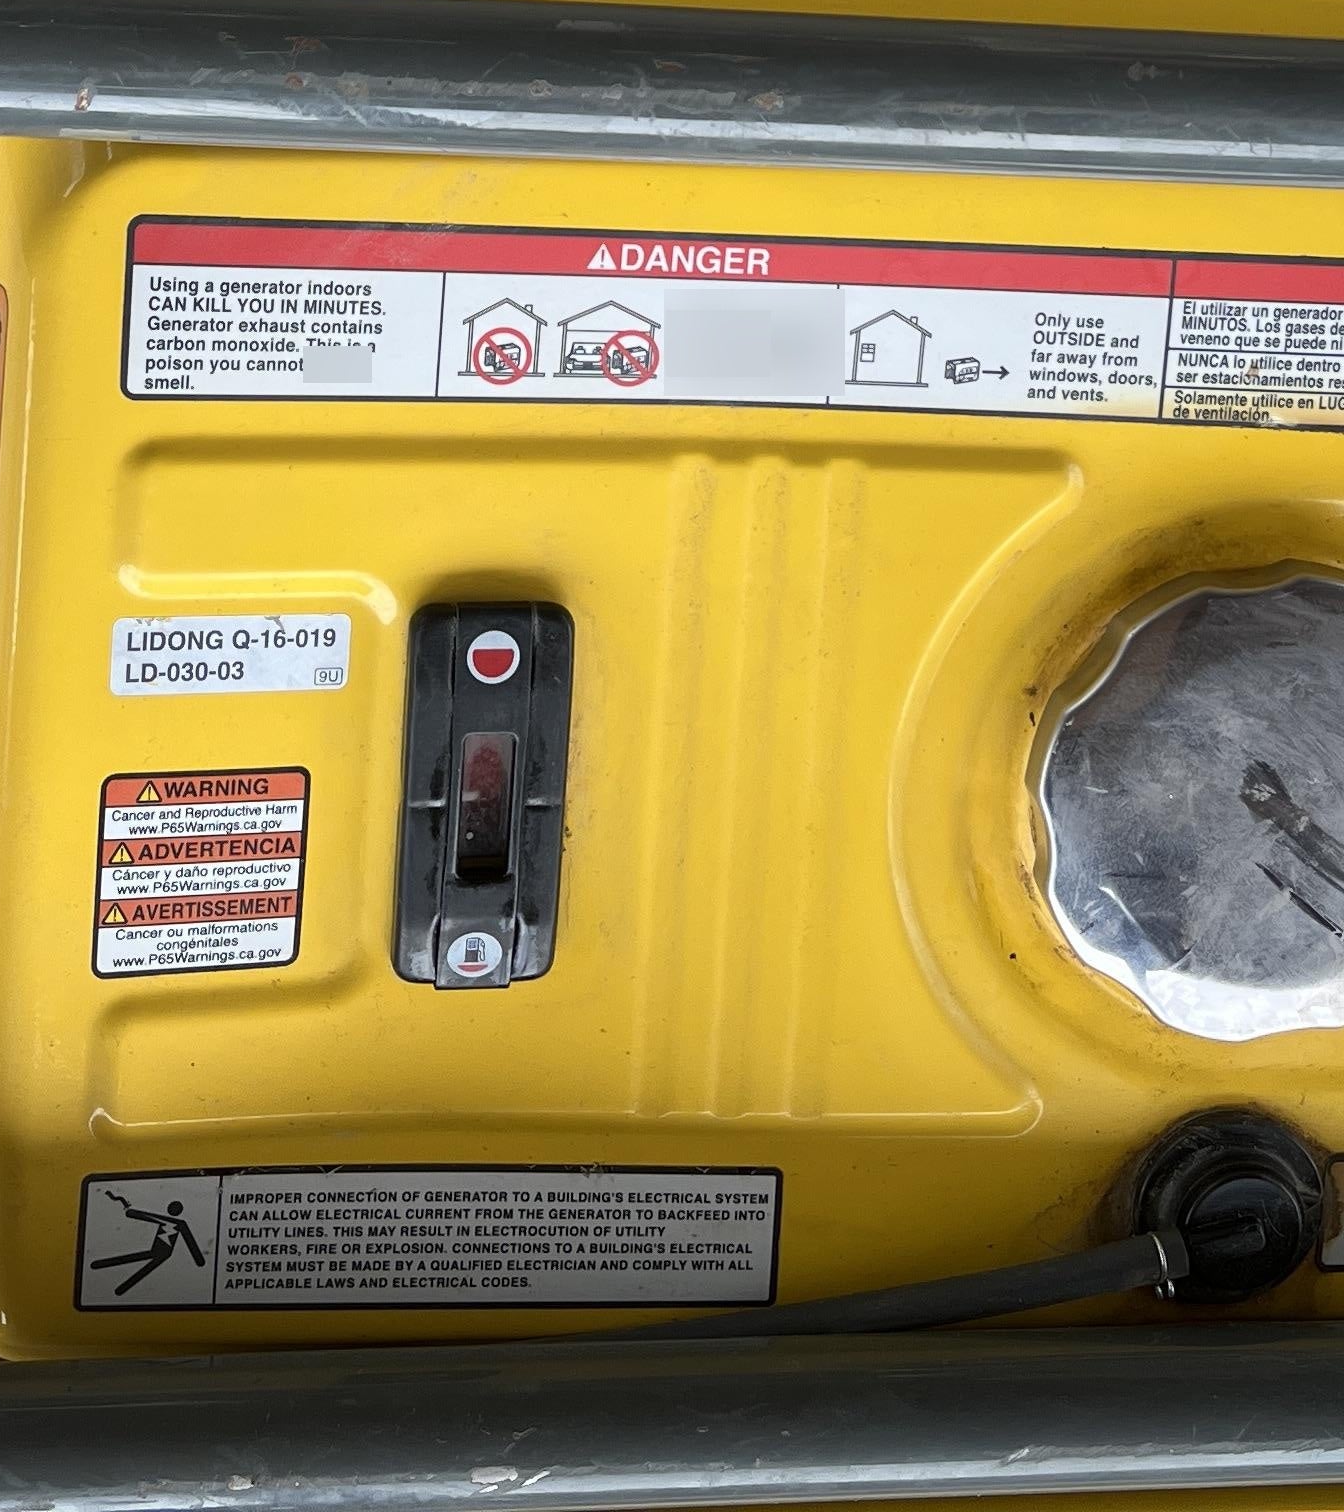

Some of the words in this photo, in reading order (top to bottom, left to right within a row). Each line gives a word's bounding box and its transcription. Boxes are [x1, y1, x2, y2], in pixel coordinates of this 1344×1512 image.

[620, 244, 770, 275] DANGER
[149, 276, 199, 297] Using
[204, 281, 214, 293] a
[219, 278, 302, 299] generator
[307, 280, 372, 296] indoors
[148, 297, 186, 312] CAN
[192, 297, 232, 313] KILL
[236, 298, 274, 314] YOU
[280, 299, 297, 314] IN
[303, 299, 386, 316] MINUTES.
[1182, 302, 1196, 314] El
[1200, 302, 1248, 316] utilizar
[1251, 307, 1268, 317] un
[1272, 305, 1344, 323] generador
[147, 315, 233, 332] Generator
[238, 317, 306, 334] exhaust
[310, 318, 383, 335] contains
[1033, 313, 1070, 332] Only
[1075, 317, 1104, 329] use
[146, 336, 205, 351] carbon
[211, 337, 300, 353] monoxide.
[1032, 332, 1105, 347] OUTSIDE
[1110, 334, 1139, 348] and
[144, 355, 203, 374] poison
[208, 359, 240, 375] you
[245, 356, 304, 372] cannot
[1030, 350, 1052, 364] far
[1056, 354, 1096, 369] away
[1101, 351, 1138, 366] from
[144, 374, 195, 390] smell.
[1028, 369, 1102, 388] windows,
[1107, 370, 1157, 389] doors,
[1026, 385, 1056, 400] and
[1060, 386, 1108, 402] vents.
[1172, 406, 1190, 419] de
[1193, 407, 1273, 421] ventilación.
[127, 629, 223, 652] LIDONG
[231, 626, 336, 654] Q-16-019
[125, 662, 244, 684] LD-030-03
[318, 670, 340, 685] 9U
[164, 778, 269, 799] WARNING
[111, 809, 155, 823] Cancer
[158, 808, 181, 821] and
[184, 804, 261, 823] Reproductive
[265, 803, 297, 817] Harm
[128, 818, 282, 837] www.P65Warnings.ca.gov
[138, 838, 296, 860] ADVERTENCIA
[111, 867, 160, 882] Cáncer
[163, 870, 171, 883] y
[175, 865, 208, 879] daño
[212, 861, 291, 881] reproductivo
[117, 876, 287, 896] www.P65Warnings.ca.gov
[132, 897, 292, 922] AVERTISSEMENT
[115, 925, 162, 940] Cancer
[166, 927, 183, 938] ou
[187, 920, 278, 937] malformations
[156, 935, 239, 952] congénitales
[112, 948, 282, 969] www.P65Warnings.ca.gov
[230, 1192, 302, 1204] IMPROPER
[306, 1191, 397, 1203] CONNECTION
[401, 1191, 420, 1202] OF
[423, 1191, 508, 1202] GENERATOR
[511, 1191, 530, 1203] TO
[533, 1191, 543, 1203] A
[546, 1191, 624, 1203] BUILDING'S
[627, 1192, 711, 1204] ELECTRICAL
[714, 1192, 769, 1204] SYSTEM
[228, 1210, 258, 1221] CAN
[261, 1209, 312, 1221] ALLOW
[315, 1209, 402, 1220] ELECTRICAL
[404, 1208, 471, 1220] CURRENT
[474, 1209, 513, 1220] FROM
[517, 1209, 544, 1220] THE
[548, 1209, 631, 1220] GENERATOR
[634, 1209, 653, 1220] TO
[657, 1209, 730, 1221] BACKFEED
[733, 1210, 765, 1221] INTO
[228, 1227, 280, 1238] UTILITY
[284, 1226, 328, 1238] LINES.
[332, 1226, 363, 1237] THIS
[367, 1226, 396, 1237] MAY
[400, 1225, 453, 1237] RESULT
[456, 1225, 470, 1236] IN
[474, 1225, 589, 1237] ELECTROCUTION
[592, 1226, 611, 1237] OF
[614, 1226, 665, 1237] UTILITY
[224, 1277, 312, 1289] APPLICABLE
[316, 1277, 355, 1288] LAWS
[358, 1277, 388, 1288] AND
[392, 1276, 477, 1288] ELECTRICAL
[480, 1276, 531, 1287] CODES.
